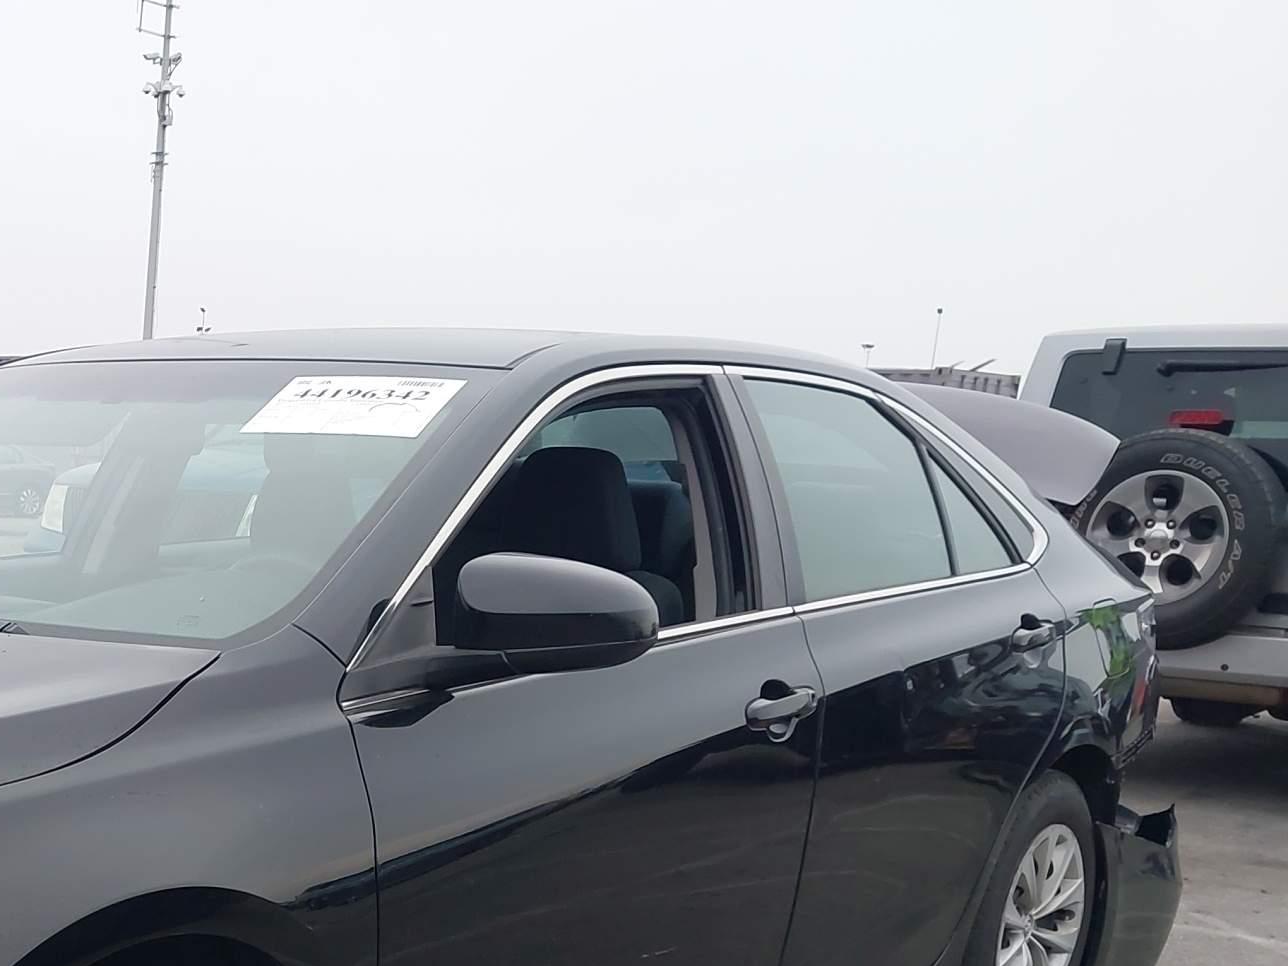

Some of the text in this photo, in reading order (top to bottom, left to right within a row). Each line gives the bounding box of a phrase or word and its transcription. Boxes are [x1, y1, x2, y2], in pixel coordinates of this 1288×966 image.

[294, 388, 430, 401] 44196342
[1160, 453, 1245, 590] DUELER A/T
